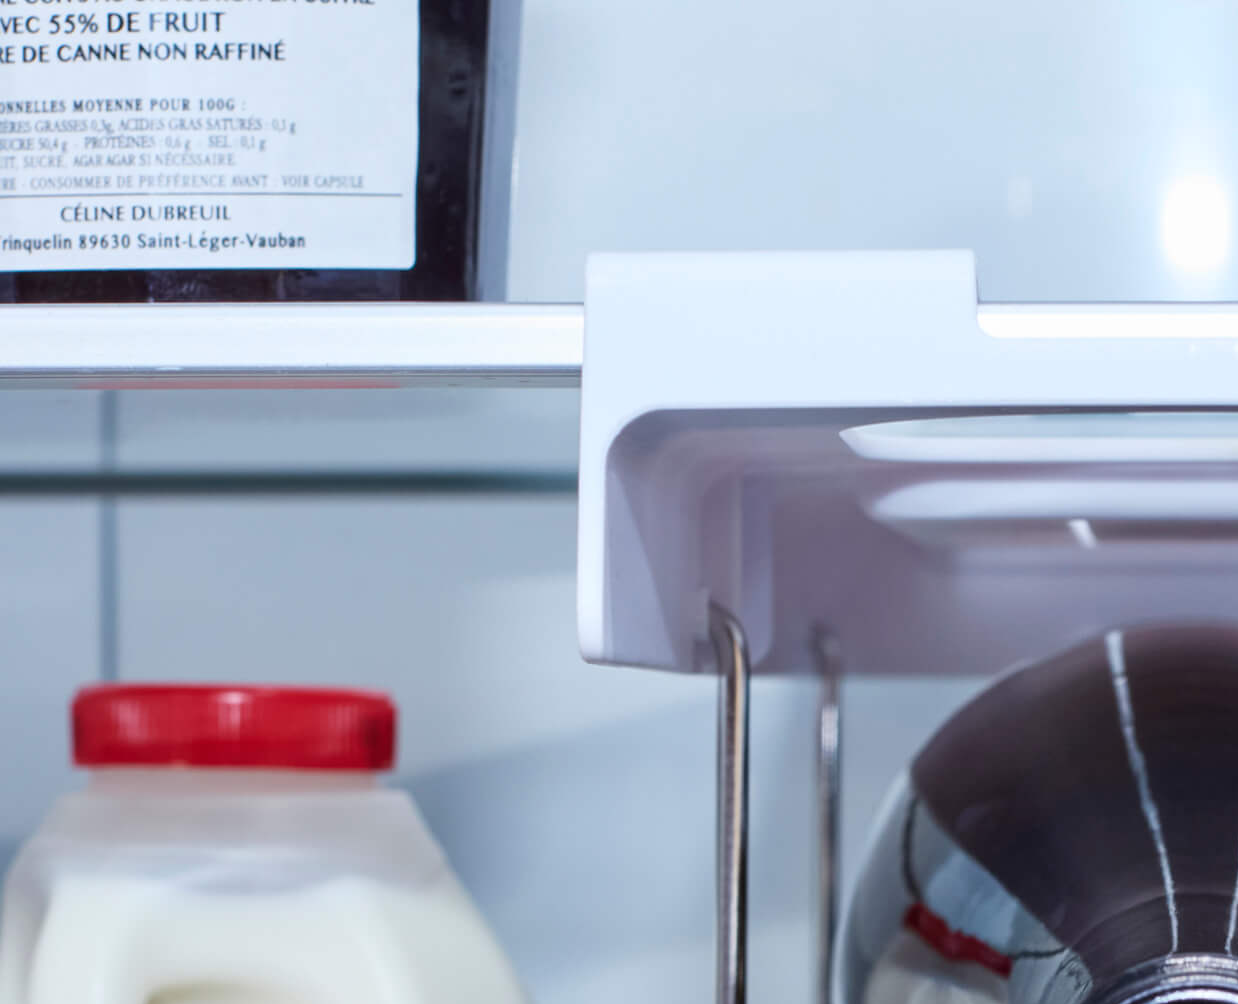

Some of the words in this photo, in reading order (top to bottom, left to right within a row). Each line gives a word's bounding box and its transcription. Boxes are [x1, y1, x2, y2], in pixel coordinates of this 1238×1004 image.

[49, 13, 98, 34] 55%
[107, 12, 140, 32] DE
[150, 11, 225, 32] FRUIT
[22, 46, 49, 63] DE
[57, 44, 131, 62] CANNE
[139, 42, 187, 60] NON
[195, 38, 286, 60] RAFFINÉ
[73, 98, 142, 111] MOYENNE
[150, 98, 190, 111] POUR
[199, 98, 235, 111] 100G
[168, 117, 202, 131] GRAS
[205, 114, 262, 131] SATURÉS
[117, 175, 132, 188] DE
[60, 202, 125, 221] CÉLINE
[132, 205, 232, 220] DUBREUIL
[0, 233, 72, 254] rinquelin
[78, 233, 131, 249] 89630
[137, 229, 306, 252] Saint-Léger-Vauban
